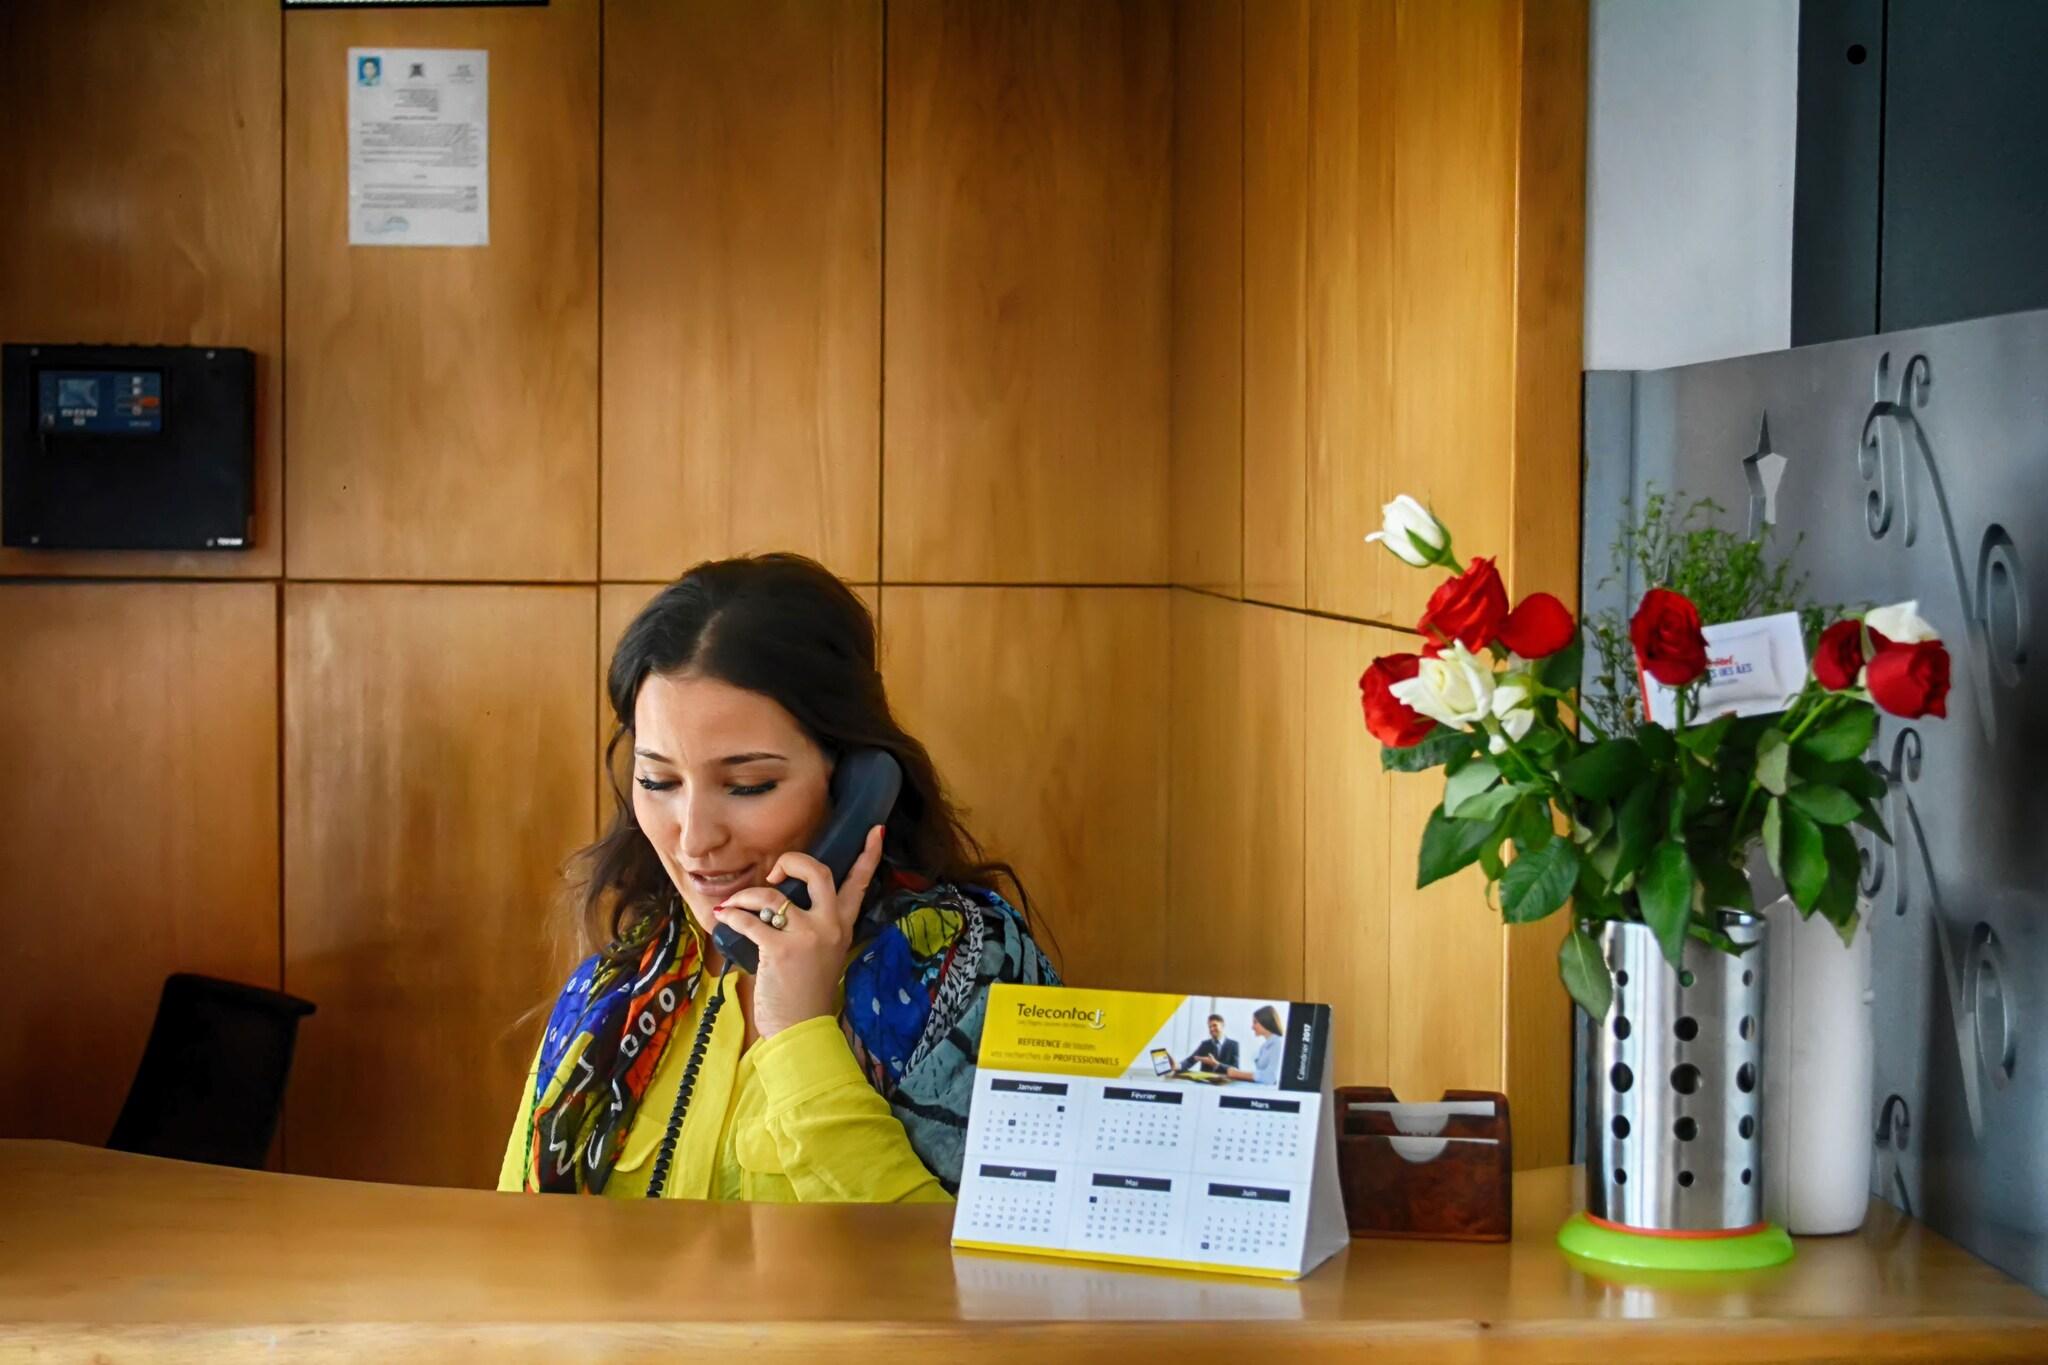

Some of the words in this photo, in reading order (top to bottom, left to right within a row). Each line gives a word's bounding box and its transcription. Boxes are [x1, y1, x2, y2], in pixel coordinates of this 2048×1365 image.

[1302, 1023, 1312, 1042] 2017
[1053, 1053, 1120, 1066] PROFESSIONNELS
[1017, 1083, 1043, 1092] Janvier
[1250, 1100, 1270, 1109] Mars
[1009, 1169, 1028, 1178] Avril
[1125, 1179, 1139, 1187] Mai
[1241, 1189, 1257, 1198] Juin
